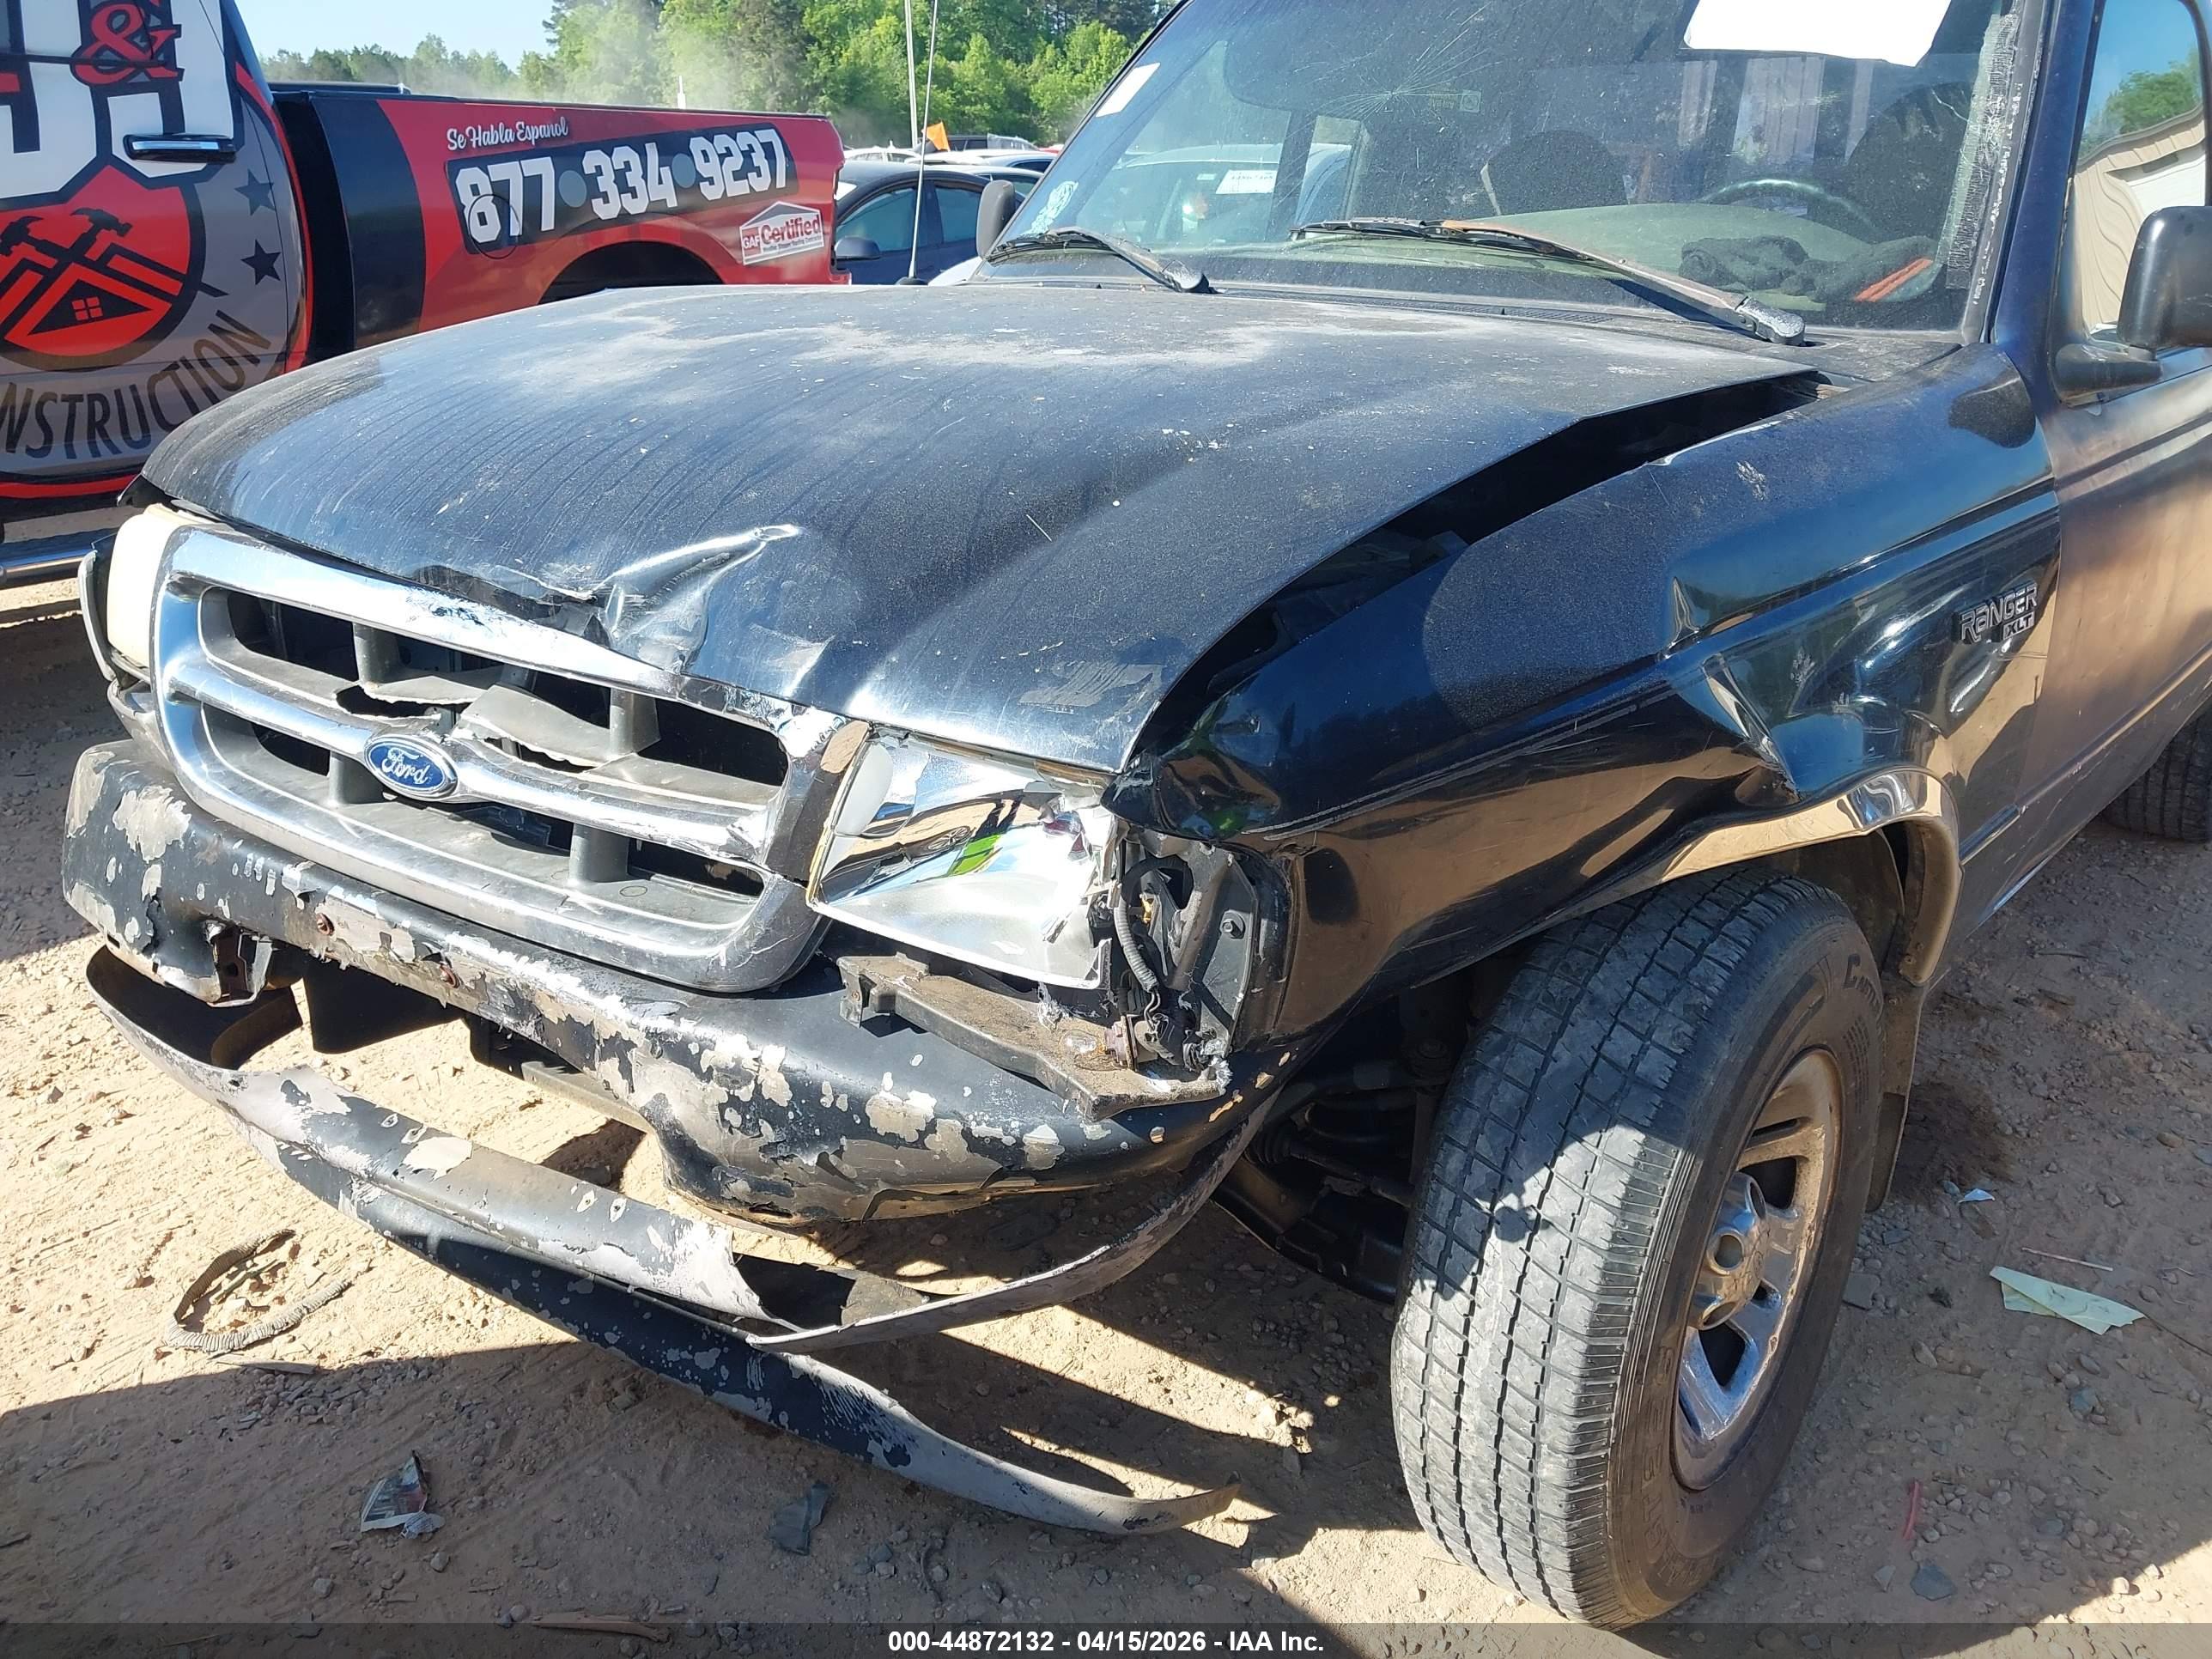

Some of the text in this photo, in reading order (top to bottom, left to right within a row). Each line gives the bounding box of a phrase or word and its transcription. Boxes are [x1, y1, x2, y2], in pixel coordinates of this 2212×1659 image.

[74, 3, 179, 84] &
[447, 116, 568, 151] Se Habla Espanol
[743, 234, 760, 250] GAF
[761, 214, 821, 245] Certified
[1959, 582, 2038, 643] RANGER
[2002, 611, 2035, 641] XLT
[381, 746, 431, 785] Ford
